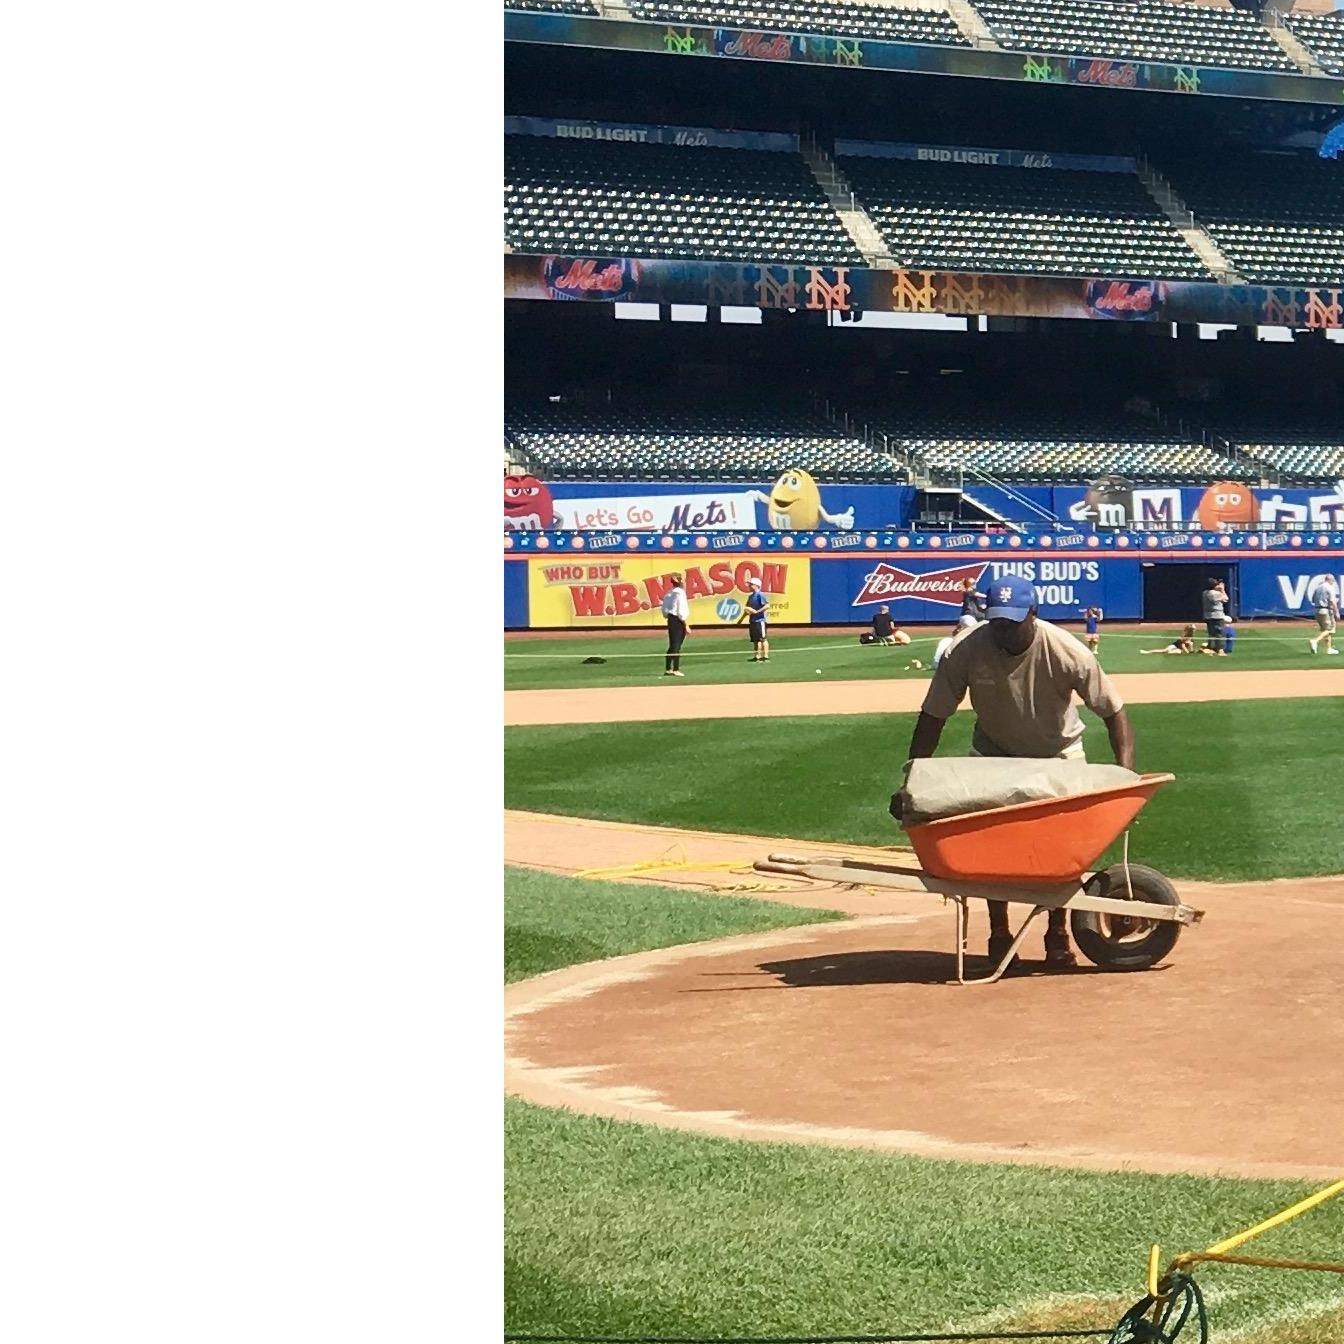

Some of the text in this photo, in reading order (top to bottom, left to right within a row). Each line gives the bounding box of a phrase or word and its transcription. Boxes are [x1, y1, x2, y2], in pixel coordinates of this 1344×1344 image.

[557, 125, 593, 139] BUD
[597, 128, 648, 143] LIGHT
[918, 148, 951, 162] BUD
[954, 151, 999, 165] LIGHT
[555, 259, 624, 291] Mets
[574, 506, 620, 530] Let's
[627, 505, 654, 524] Go
[544, 564, 621, 582] WHO BUT
[1040, 561, 1099, 581] BUD'S
[864, 572, 967, 595] Budweise
[1034, 586, 1080, 604] YOU.
[719, 598, 738, 621] hp
